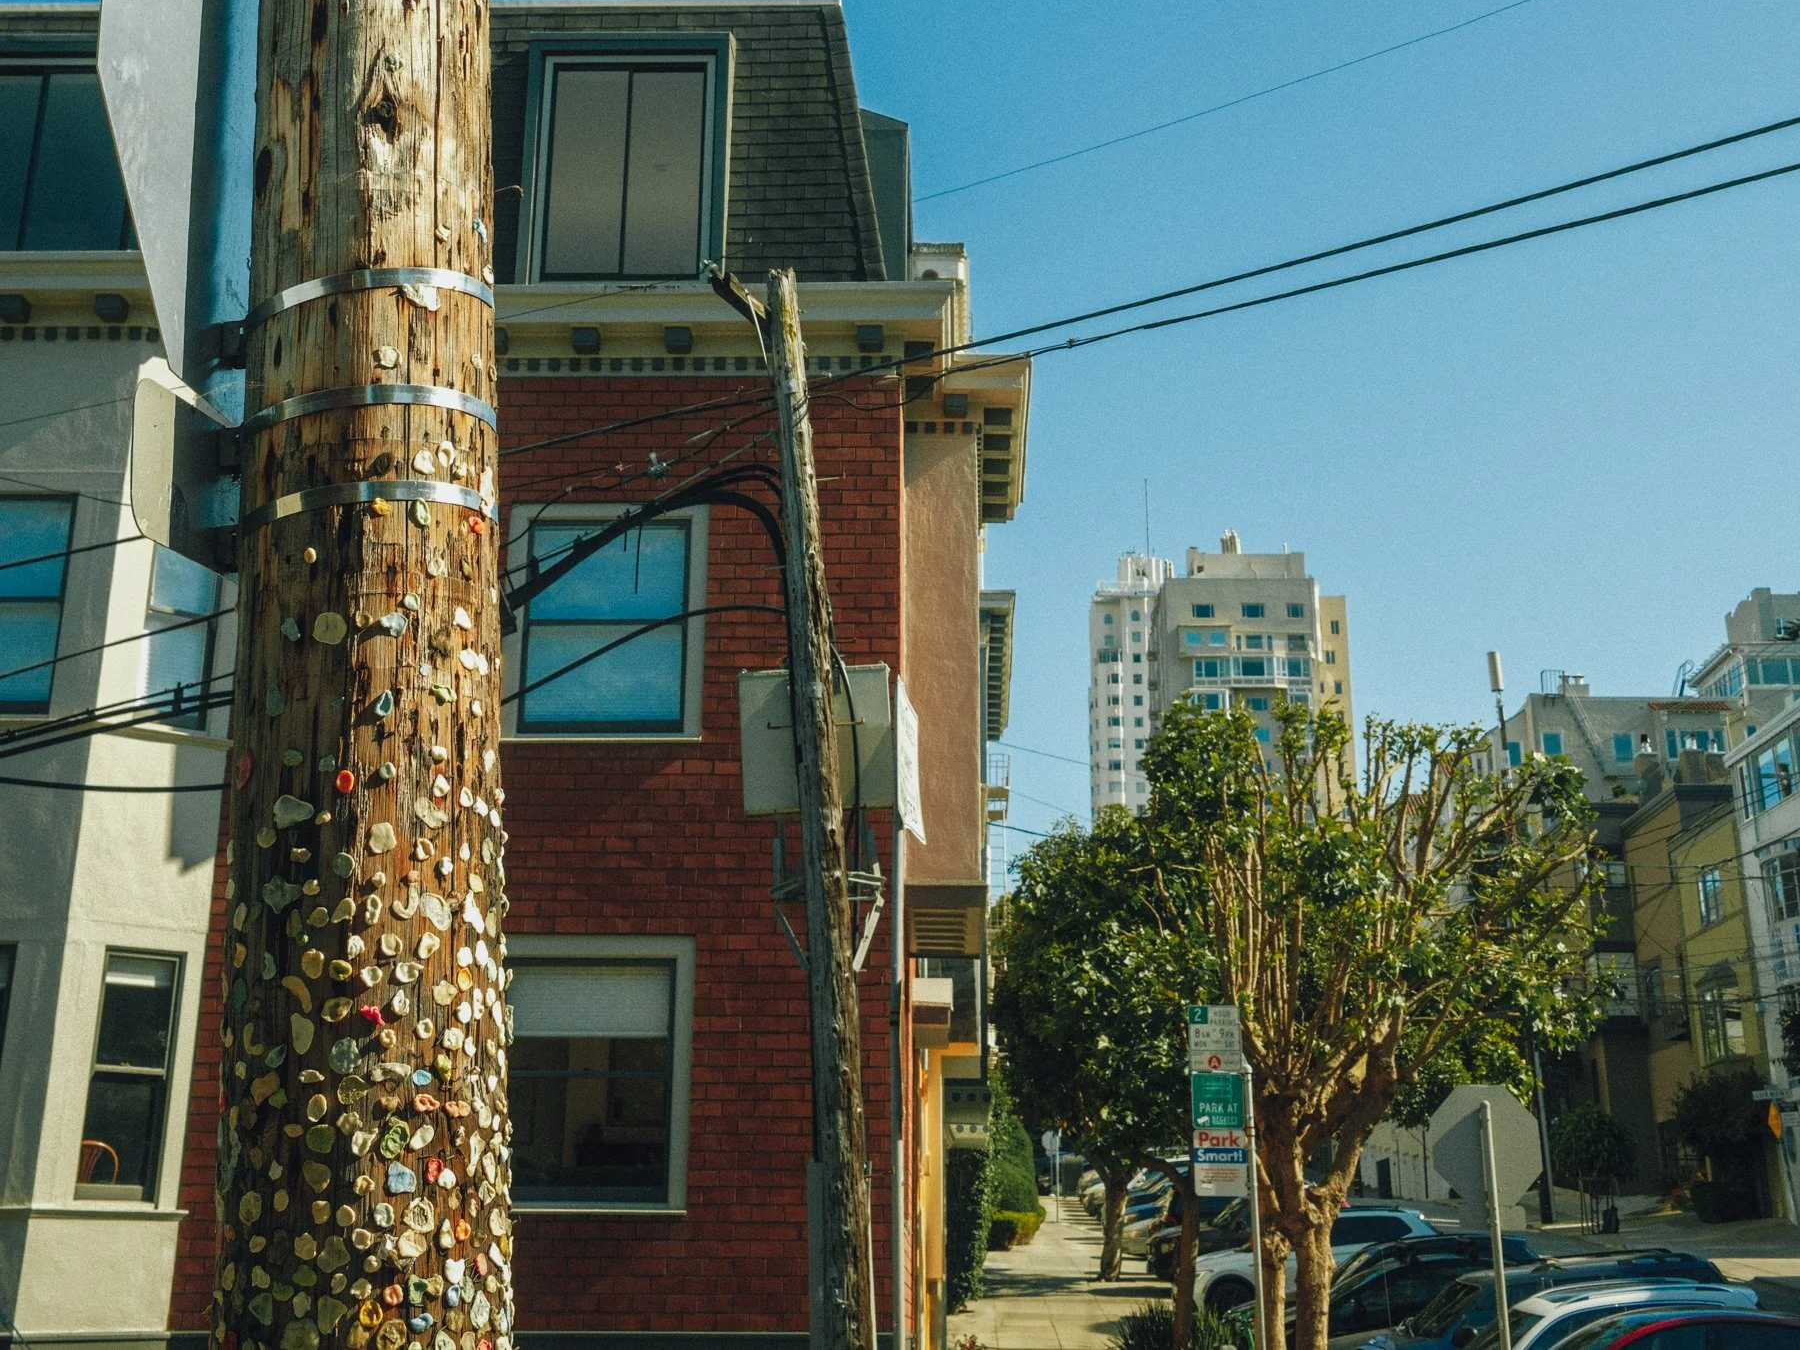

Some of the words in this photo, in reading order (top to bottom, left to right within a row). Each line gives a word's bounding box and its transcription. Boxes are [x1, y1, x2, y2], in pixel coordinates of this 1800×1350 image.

[1194, 1008, 1202, 1021] 2
[1210, 1057, 1220, 1068] A
[1199, 1102, 1224, 1113] PARK
[1227, 1103, 1238, 1113] AT
[1199, 1131, 1240, 1147] Park
[1197, 1149, 1243, 1162] Smart!
